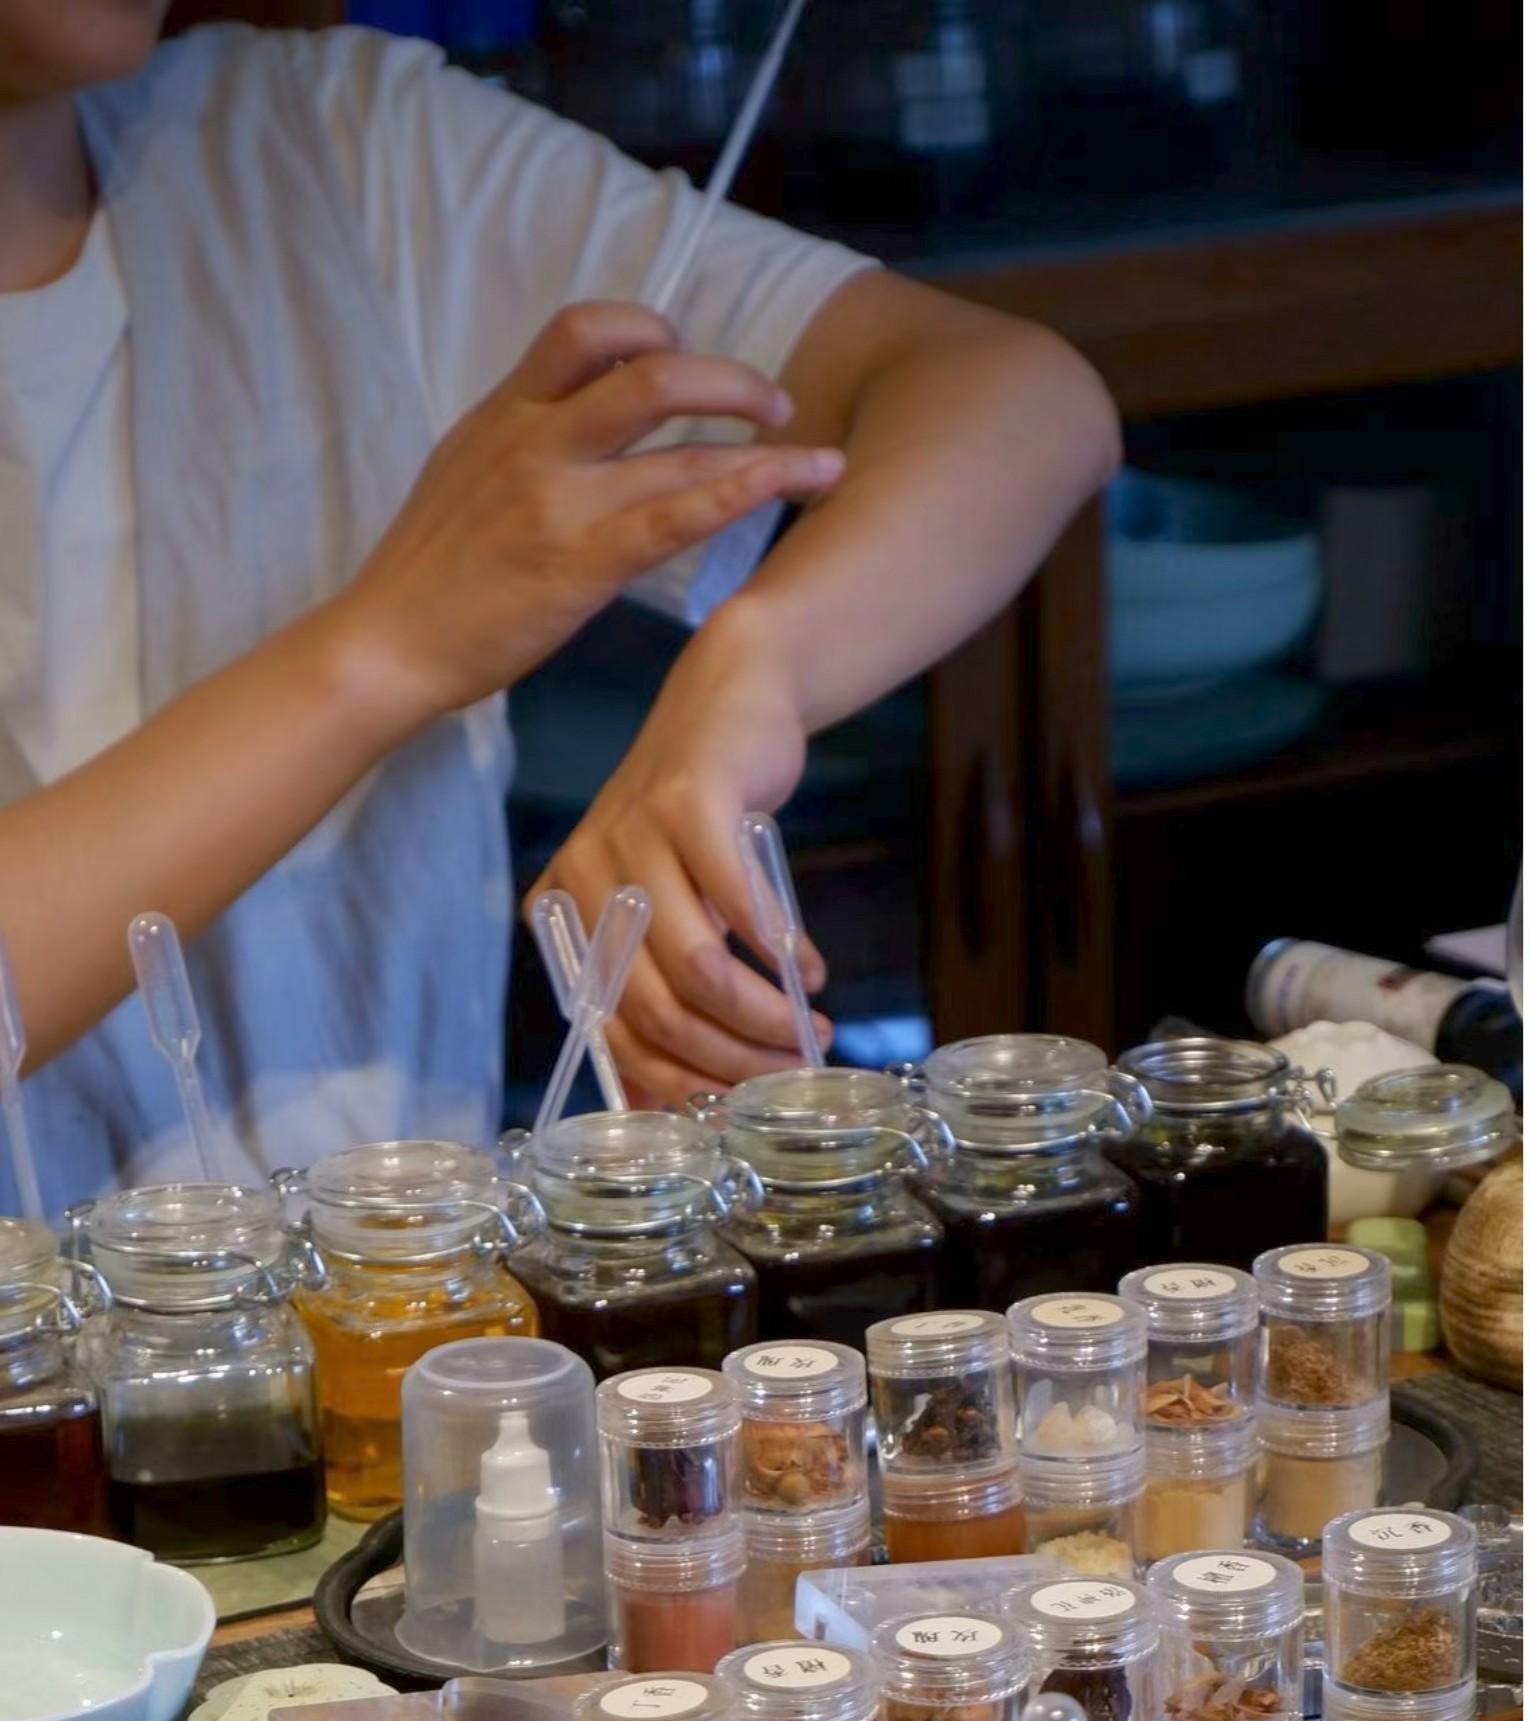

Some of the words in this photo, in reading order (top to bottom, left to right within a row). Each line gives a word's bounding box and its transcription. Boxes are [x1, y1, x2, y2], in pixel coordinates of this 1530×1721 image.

[756, 1355, 818, 1369] 玫瑰
[1369, 1520, 1434, 1541] 沉香
[1050, 1586, 1127, 1613] 洛神花
[912, 1630, 979, 1643] 玫瑰
[761, 1658, 828, 1679] 檀香
[631, 1687, 676, 1709] 丁香
